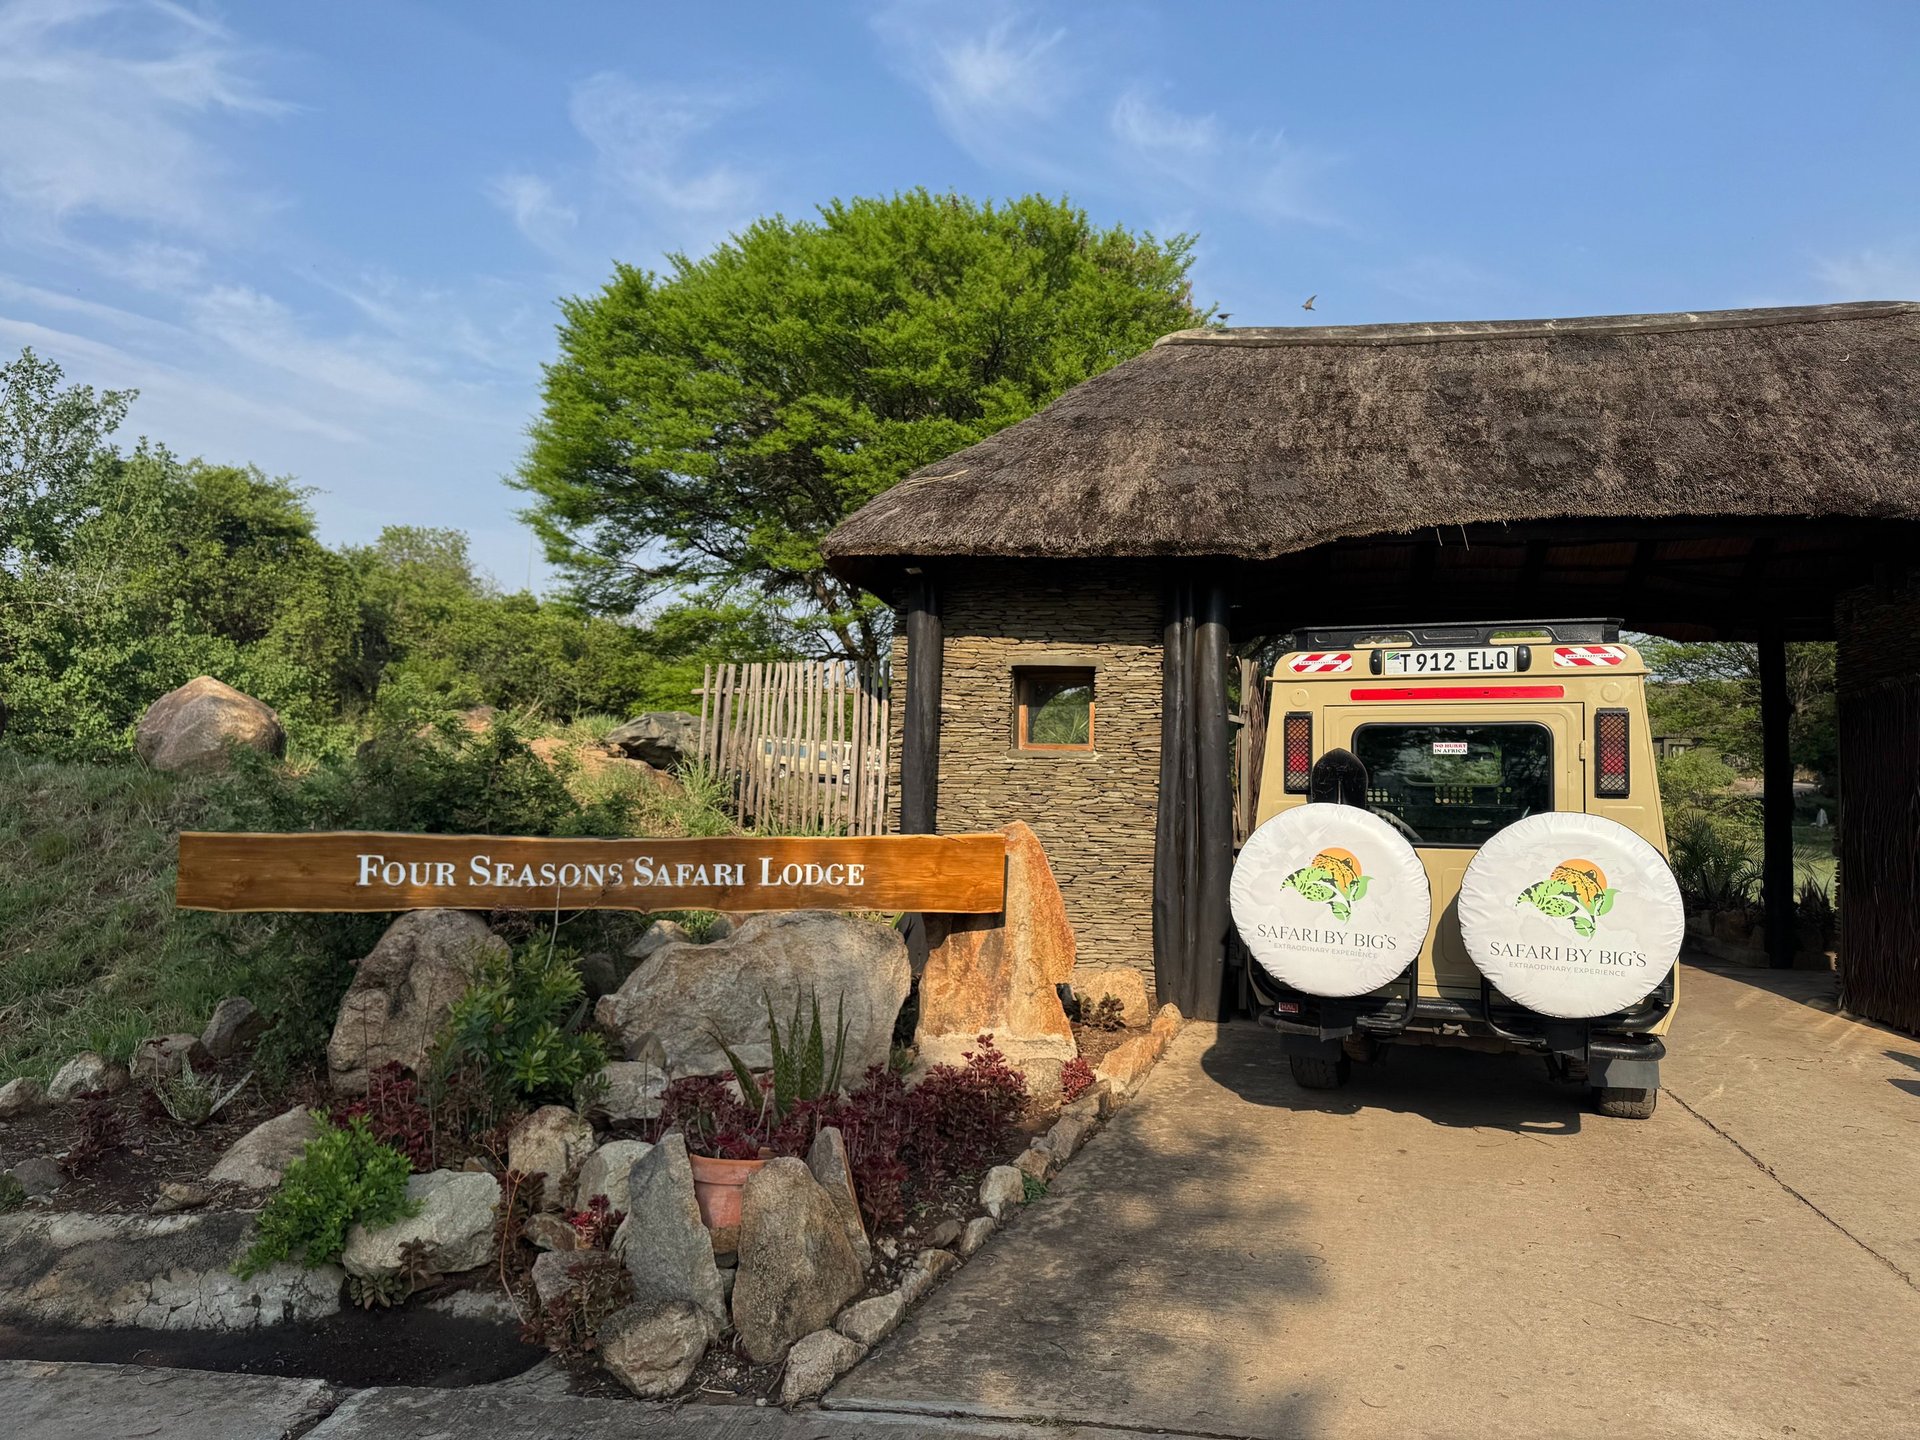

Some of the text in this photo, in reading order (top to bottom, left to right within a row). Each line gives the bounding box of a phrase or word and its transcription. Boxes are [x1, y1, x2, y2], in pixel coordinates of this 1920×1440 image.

[1400, 651, 1508, 672] T 912 ELQ
[356, 854, 866, 888] FOUR SEASONS SAFARI LODGE
[1257, 923, 1397, 951] SAFARI BY BIG'S
[1273, 942, 1378, 959] EXTRAODINARY EXPERIENCE
[1490, 941, 1647, 968] SAFARI BY BIG'S
[1508, 961, 1626, 978] EXTRAODINARY EXPERIENCE
